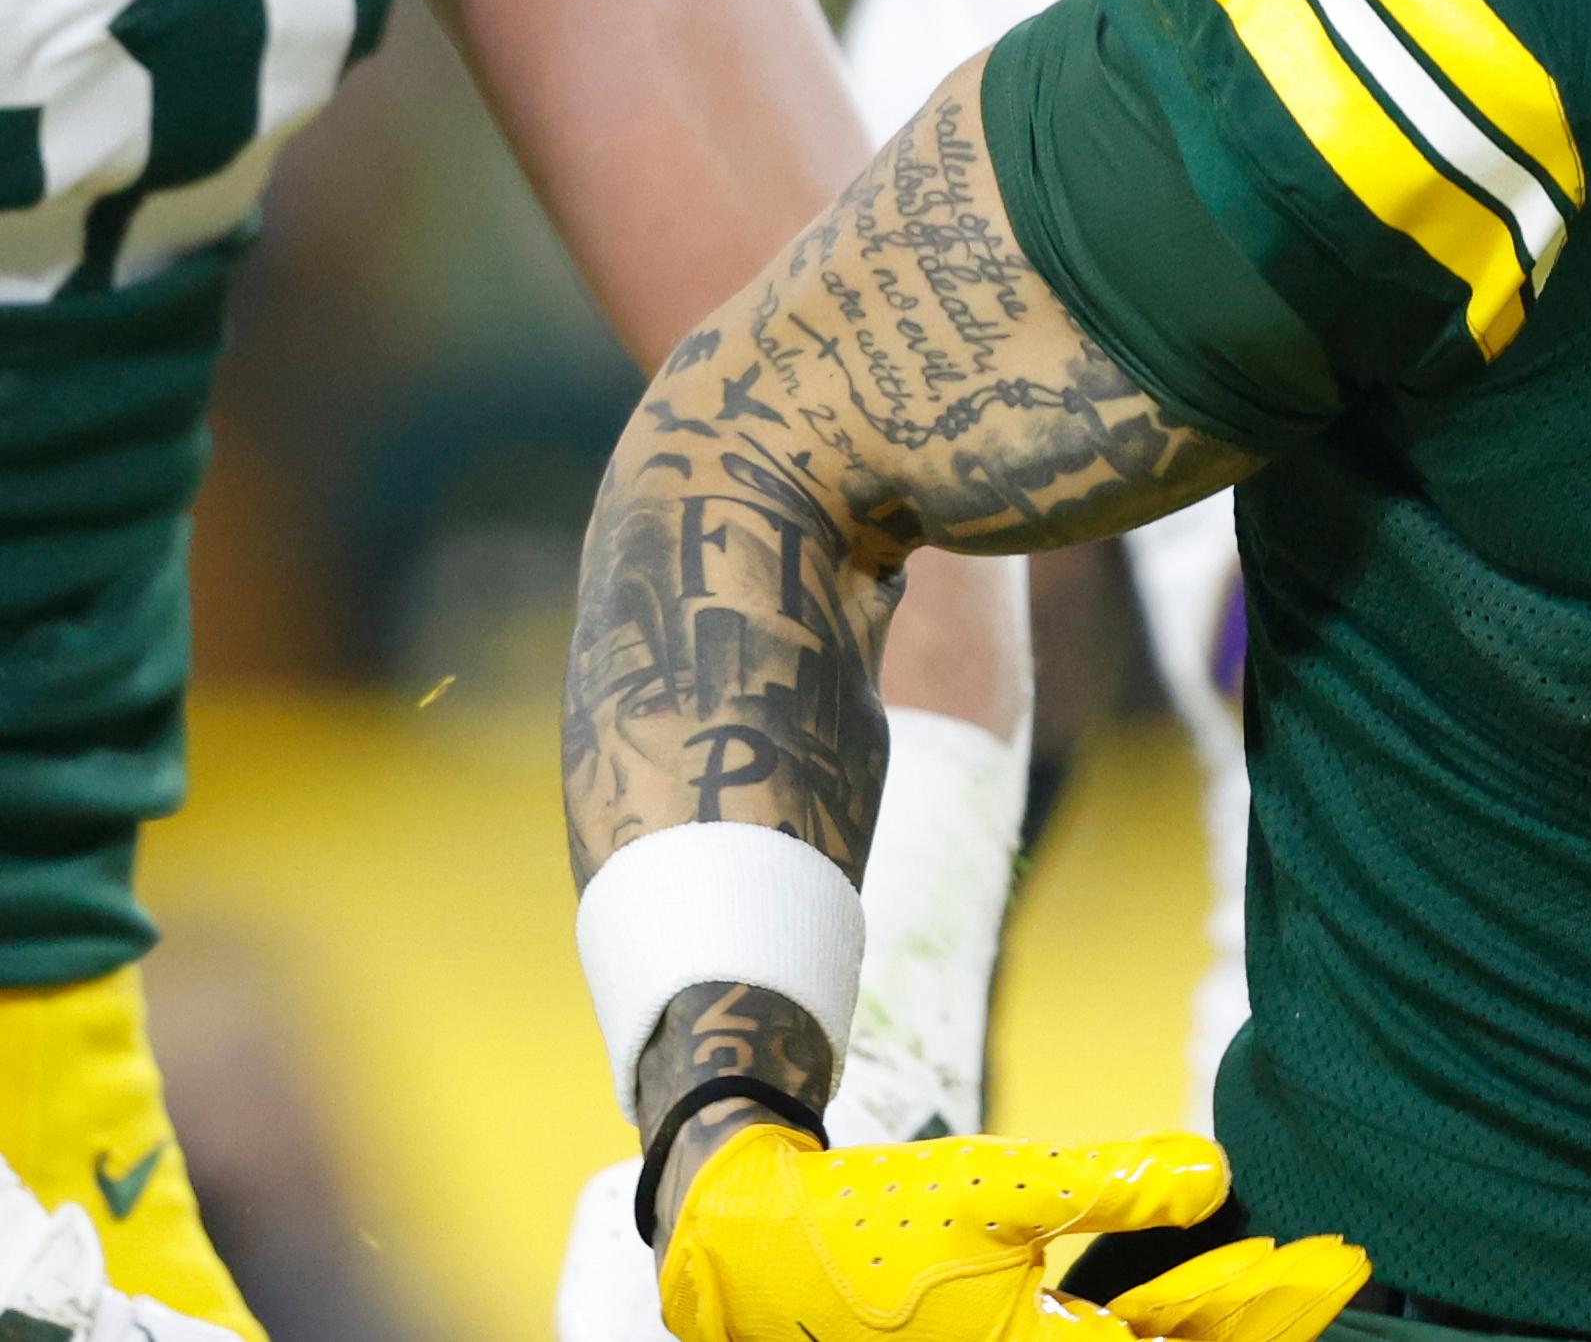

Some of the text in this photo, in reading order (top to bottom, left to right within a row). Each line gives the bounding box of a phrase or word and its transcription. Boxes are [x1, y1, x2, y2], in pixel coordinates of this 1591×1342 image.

[820, 270, 866, 324] are
[856, 329, 914, 418] with
[872, 268, 919, 311] no
[896, 318, 968, 402] evil,
